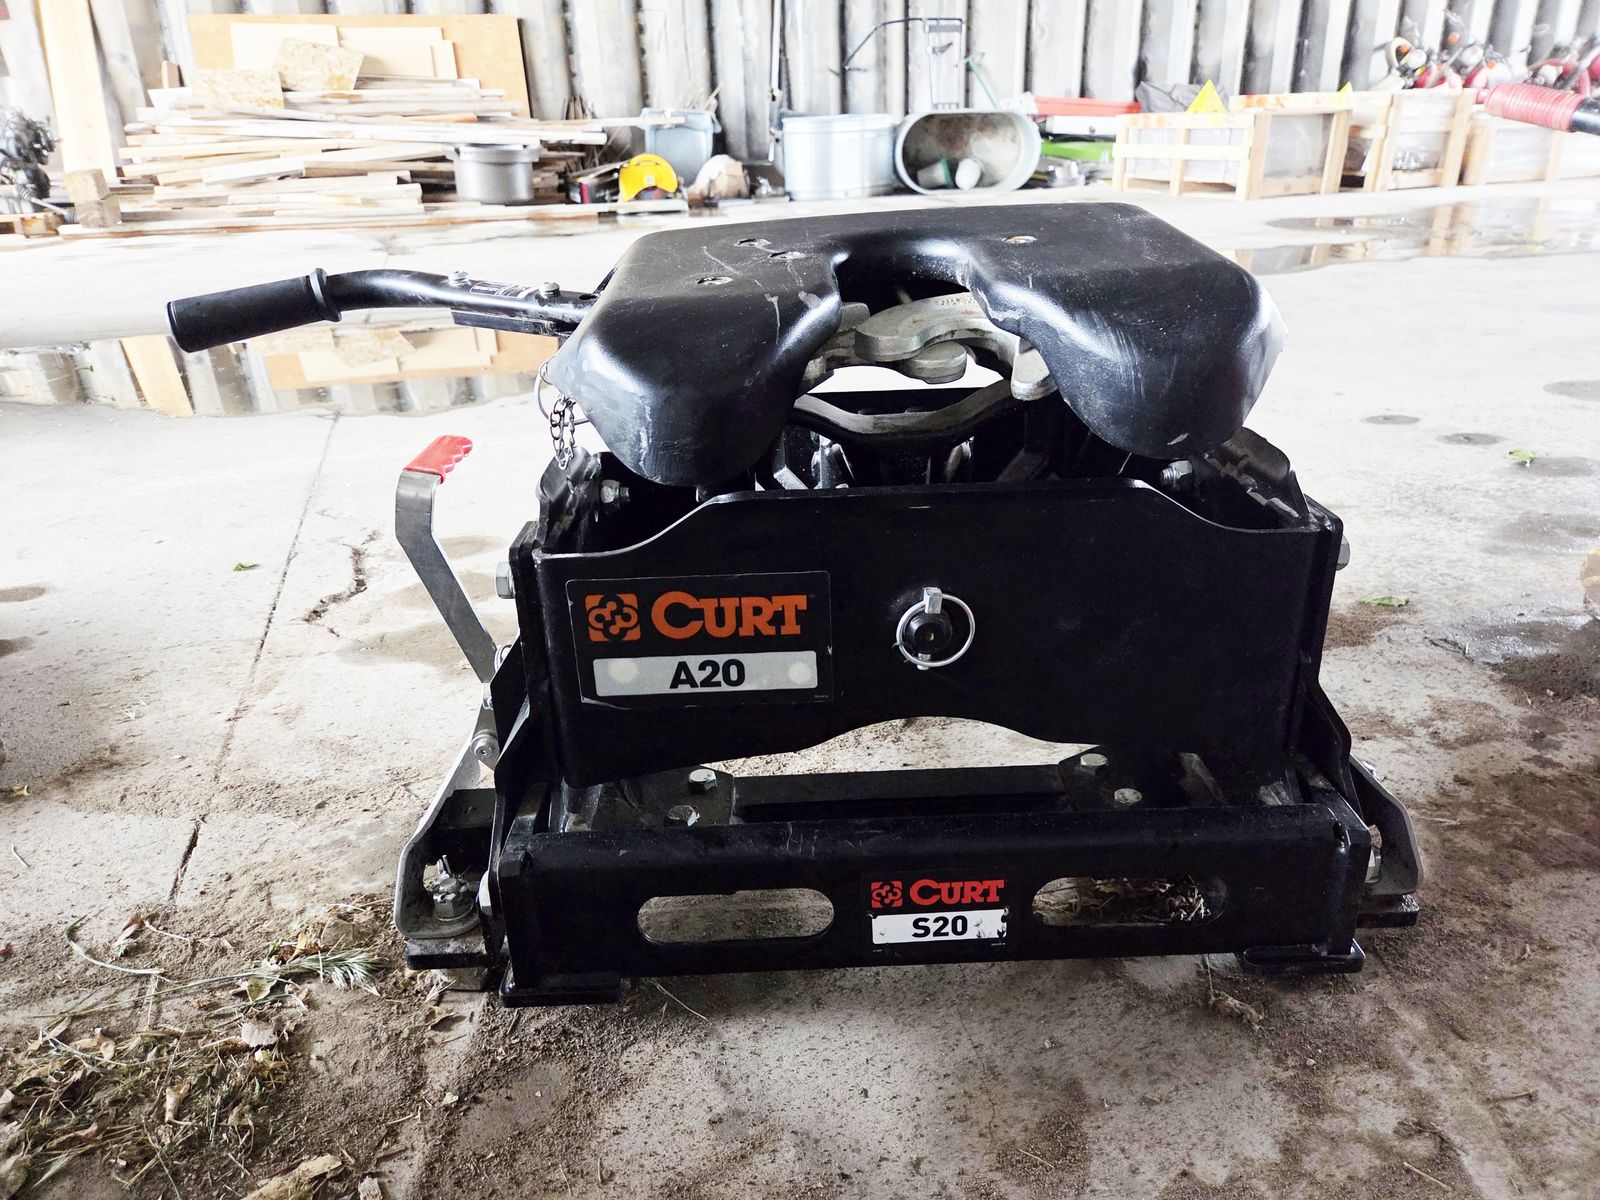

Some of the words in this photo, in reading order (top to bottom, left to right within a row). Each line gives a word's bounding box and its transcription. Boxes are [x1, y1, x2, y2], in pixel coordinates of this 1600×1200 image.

[651, 591, 807, 639] CURT
[669, 659, 746, 689] A20
[909, 879, 1005, 906] CURT
[912, 915, 968, 938] S20
